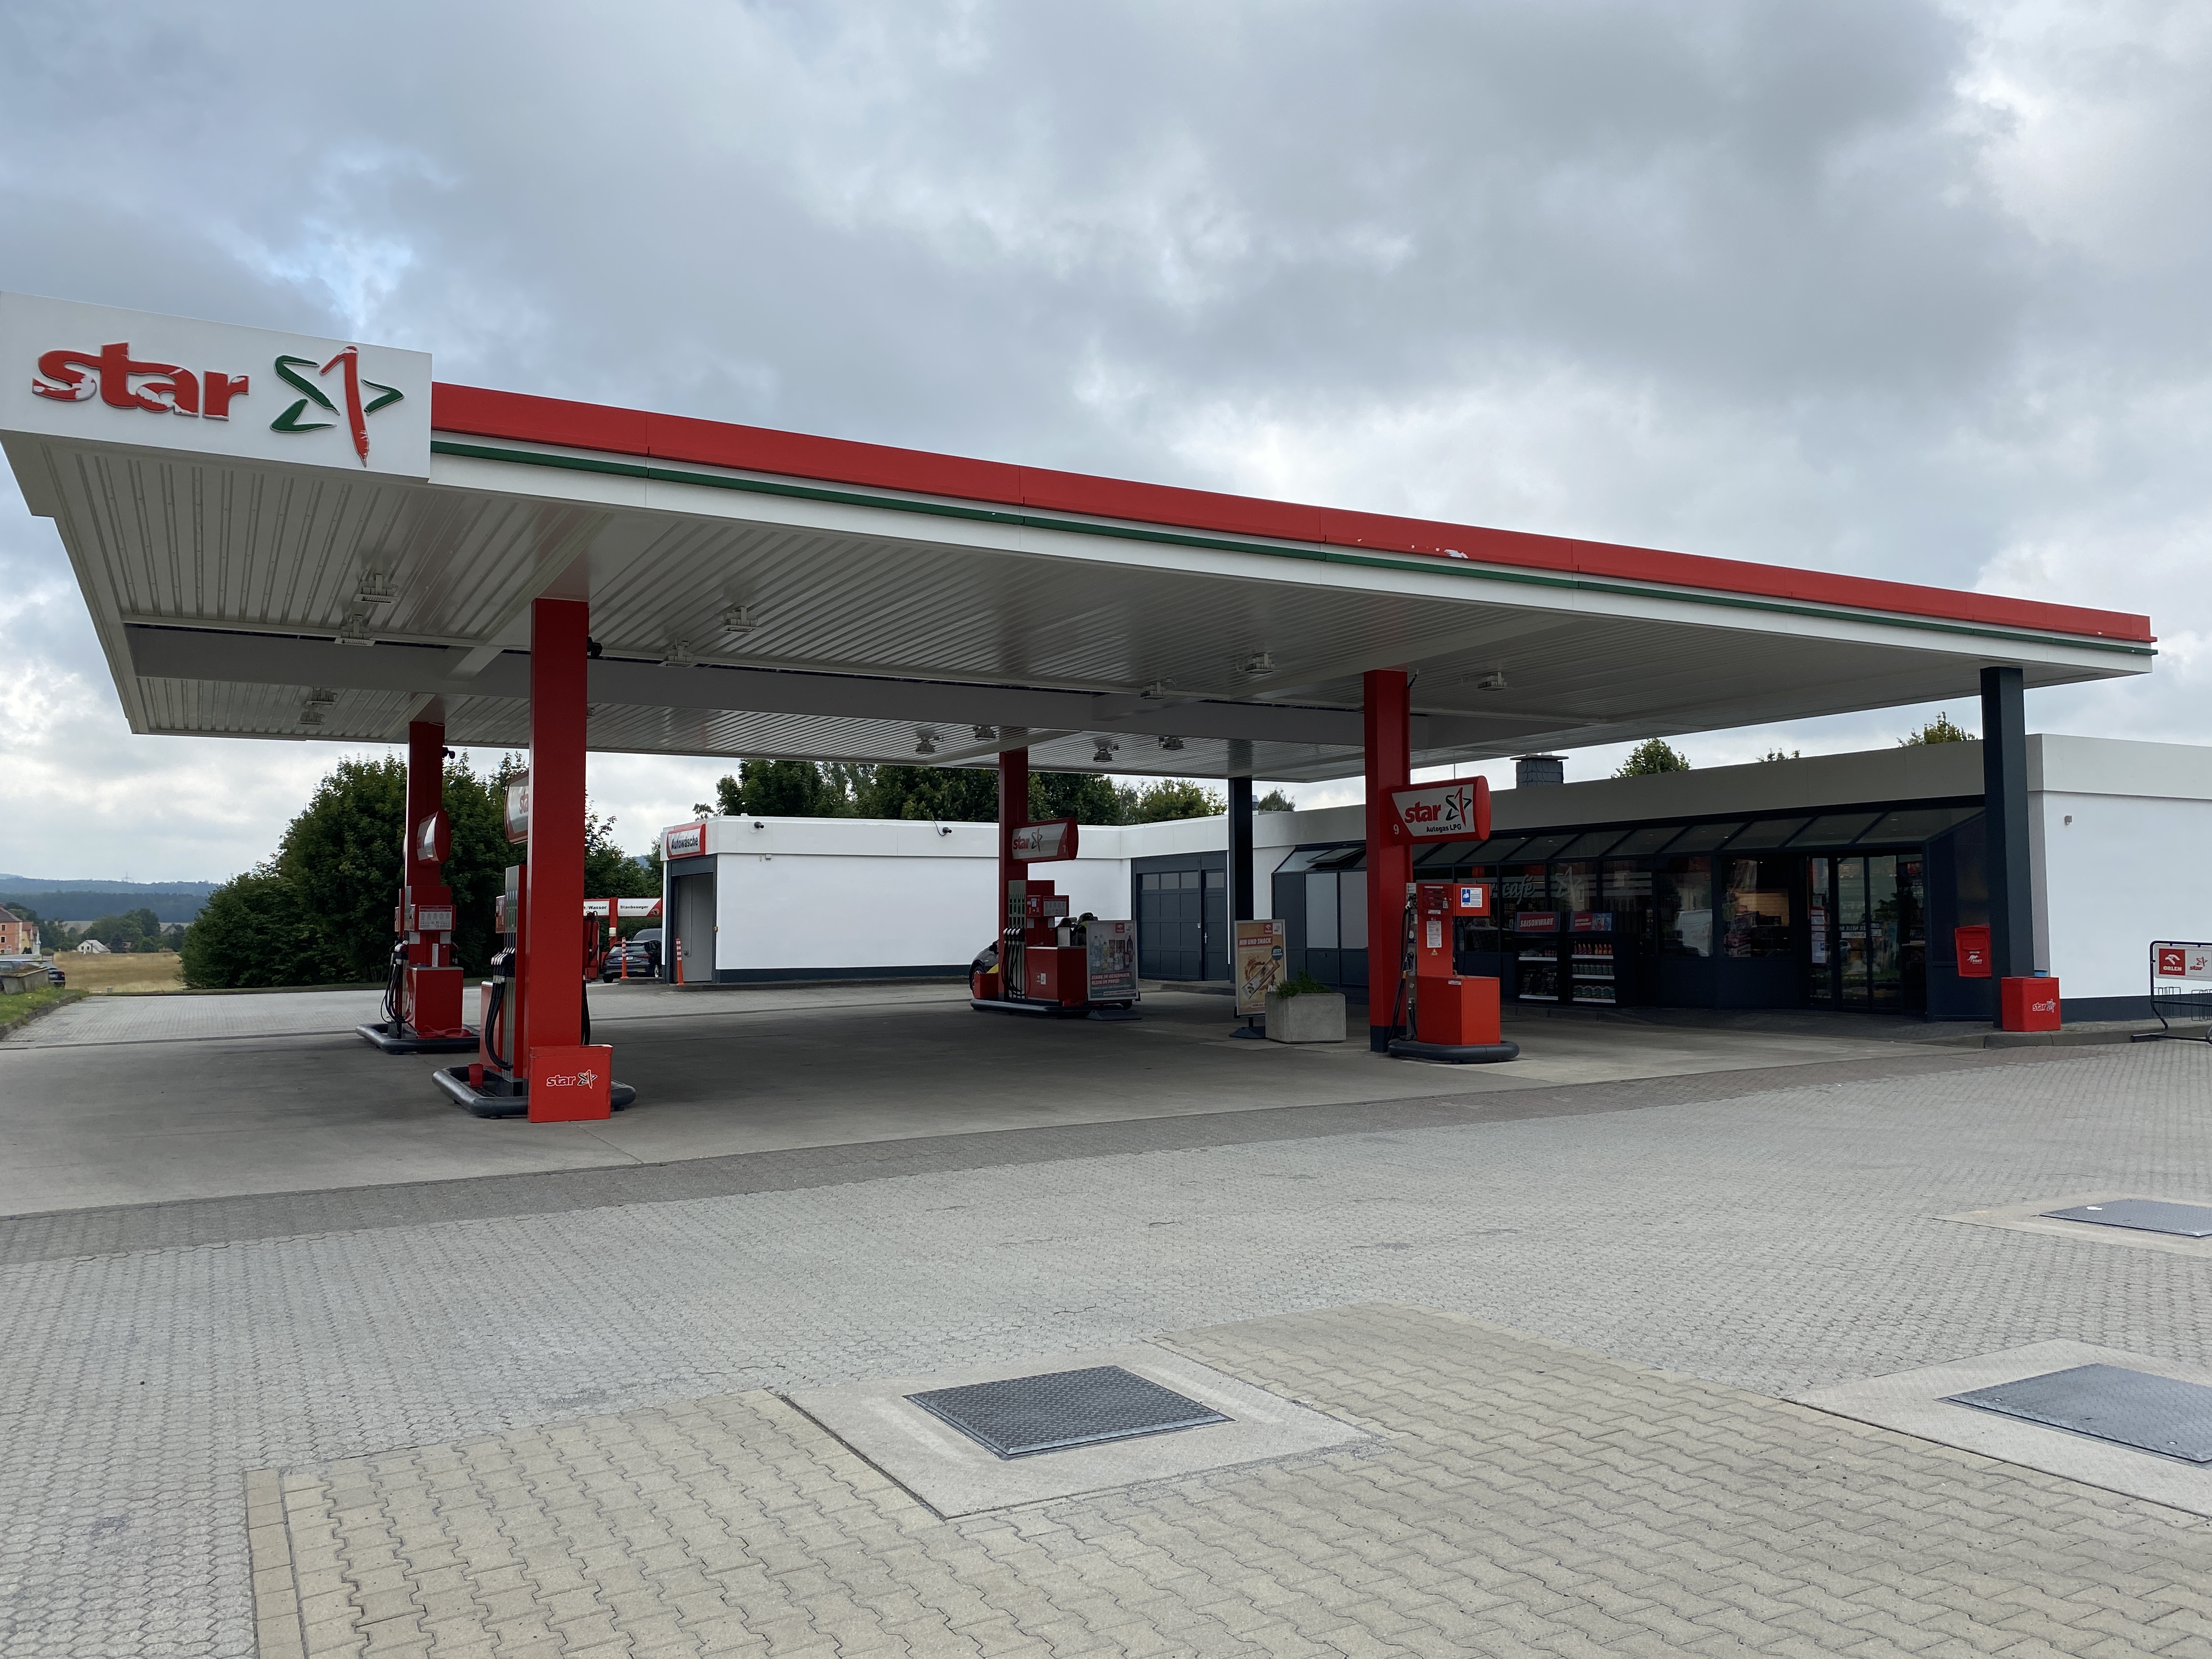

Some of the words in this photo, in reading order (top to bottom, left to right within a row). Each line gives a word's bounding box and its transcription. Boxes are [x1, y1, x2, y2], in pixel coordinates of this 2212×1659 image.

[32, 342, 250, 421] star
[1404, 801, 1442, 823] star
[1393, 824, 1400, 835] 9
[1426, 825, 1449, 833] Autogas
[671, 834, 698, 850] Autowäsche
[1013, 836, 1030, 850] star
[1502, 874, 1535, 905] café
[1520, 918, 1554, 927] SAISONWARE
[2032, 1002, 2047, 1012] star
[546, 1074, 576, 1087] star
